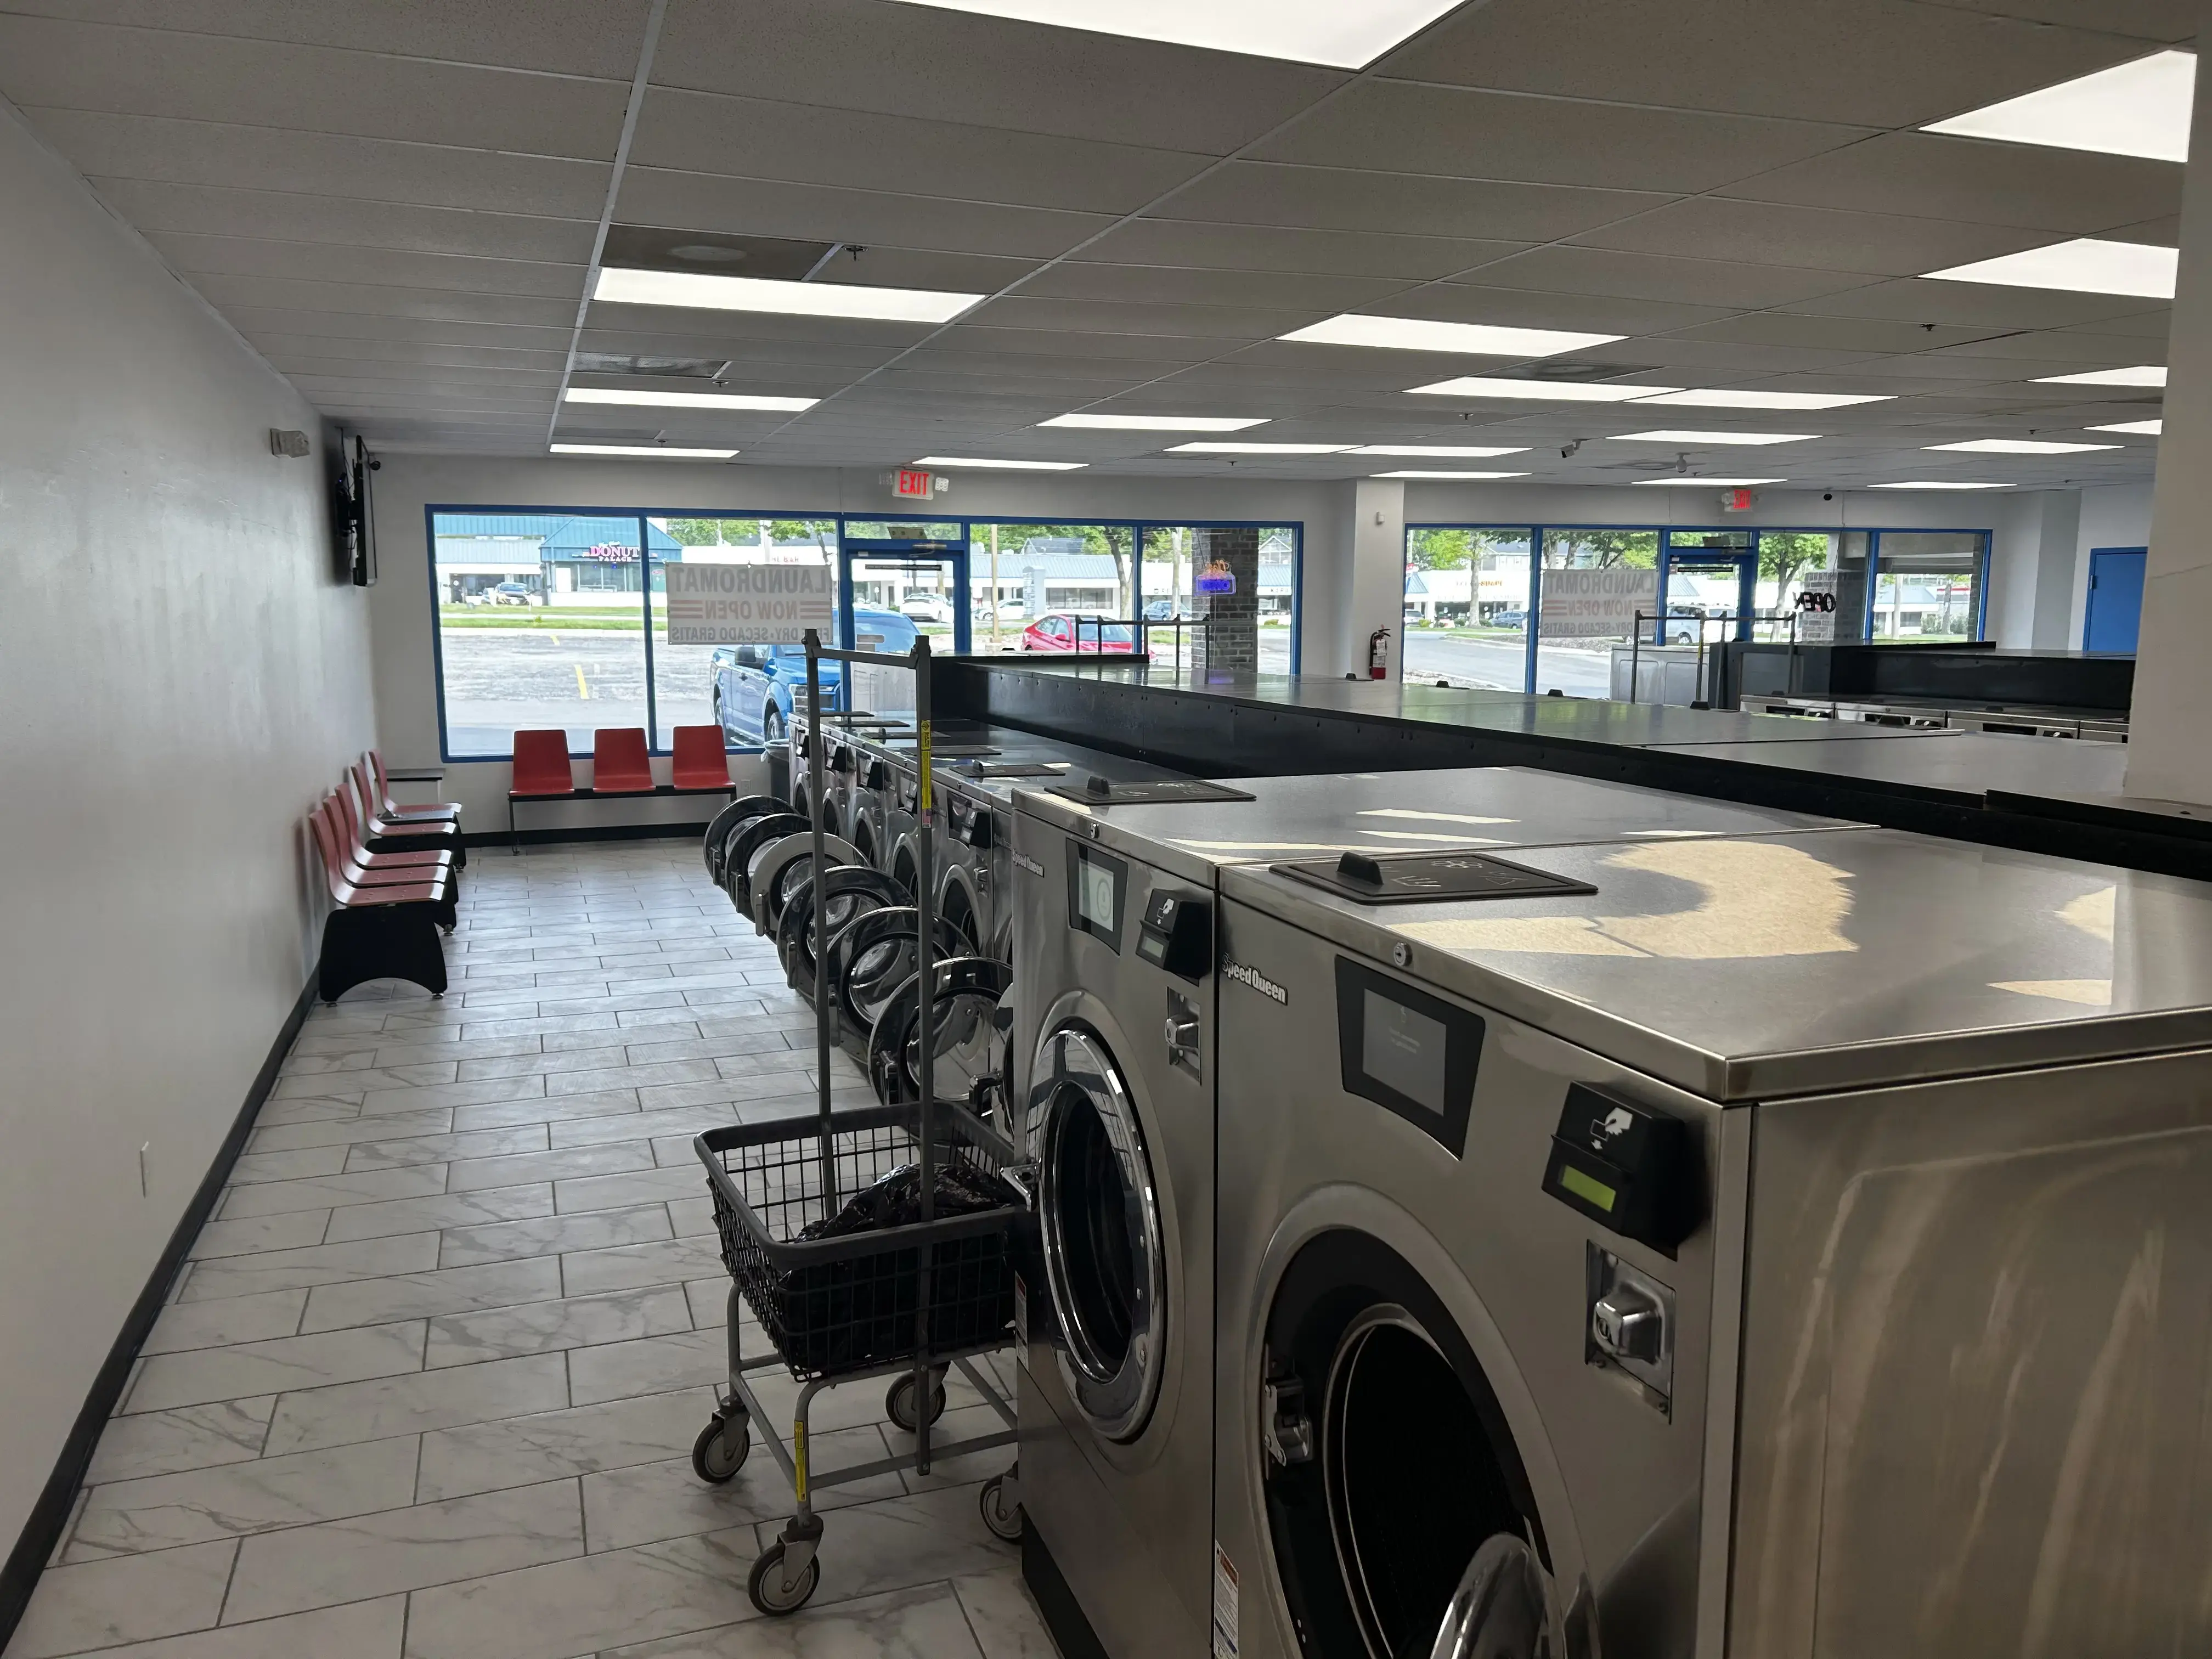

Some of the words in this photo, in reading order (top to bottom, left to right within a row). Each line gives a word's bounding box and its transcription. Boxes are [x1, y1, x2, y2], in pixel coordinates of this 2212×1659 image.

[900, 471, 929, 495] EXIT
[1733, 489, 1751, 509] EXIT
[590, 546, 640, 557] DONUT
